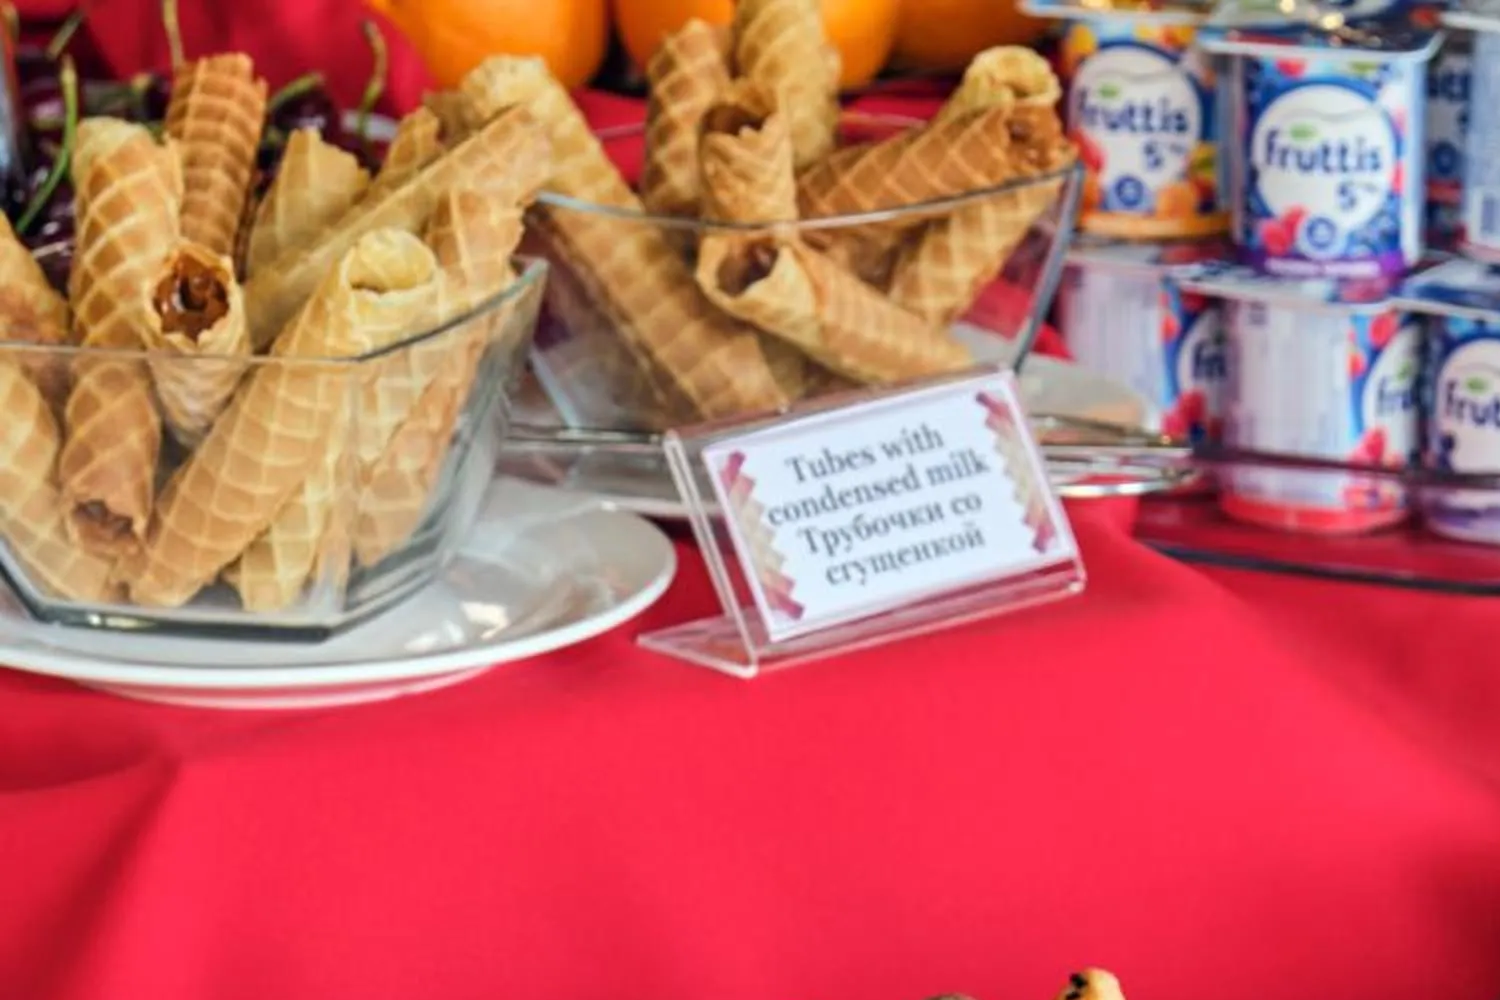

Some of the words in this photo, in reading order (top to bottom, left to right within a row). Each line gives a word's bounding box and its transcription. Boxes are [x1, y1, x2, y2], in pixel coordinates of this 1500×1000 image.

[1077, 87, 1189, 133] fruttis
[1265, 128, 1382, 173] fruttis
[786, 446, 877, 484] Tubes
[880, 422, 945, 462] with
[767, 463, 921, 528] condensed
[925, 447, 990, 487] milk
[798, 502, 944, 557] Трубочки
[950, 493, 983, 518] со
[825, 521, 986, 586] сгущенкой
